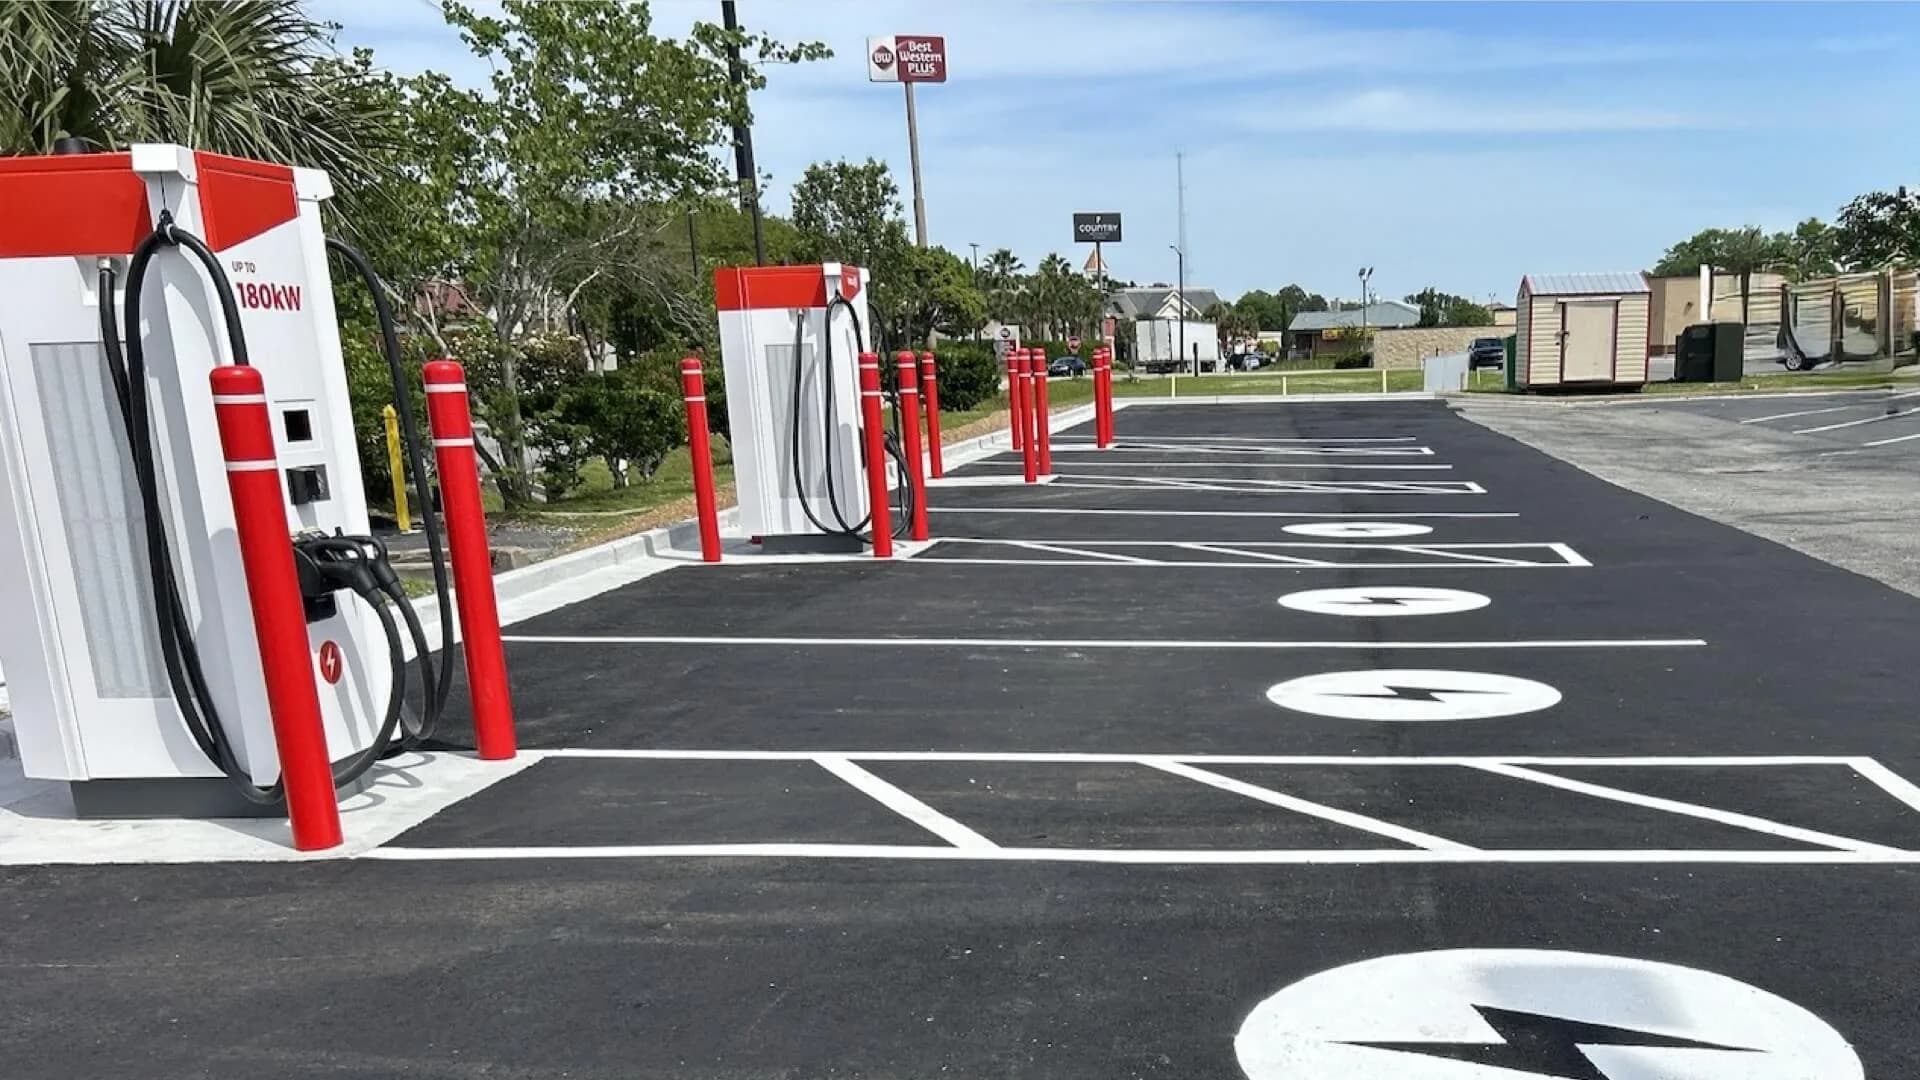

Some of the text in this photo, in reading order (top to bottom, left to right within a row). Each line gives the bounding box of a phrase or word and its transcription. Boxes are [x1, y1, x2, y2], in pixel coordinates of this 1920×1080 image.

[909, 40, 932, 52] Best
[899, 51, 942, 62] Western
[907, 62, 935, 73] PLUS
[231, 260, 256, 273] UP TO
[236, 282, 301, 311] 180kW
